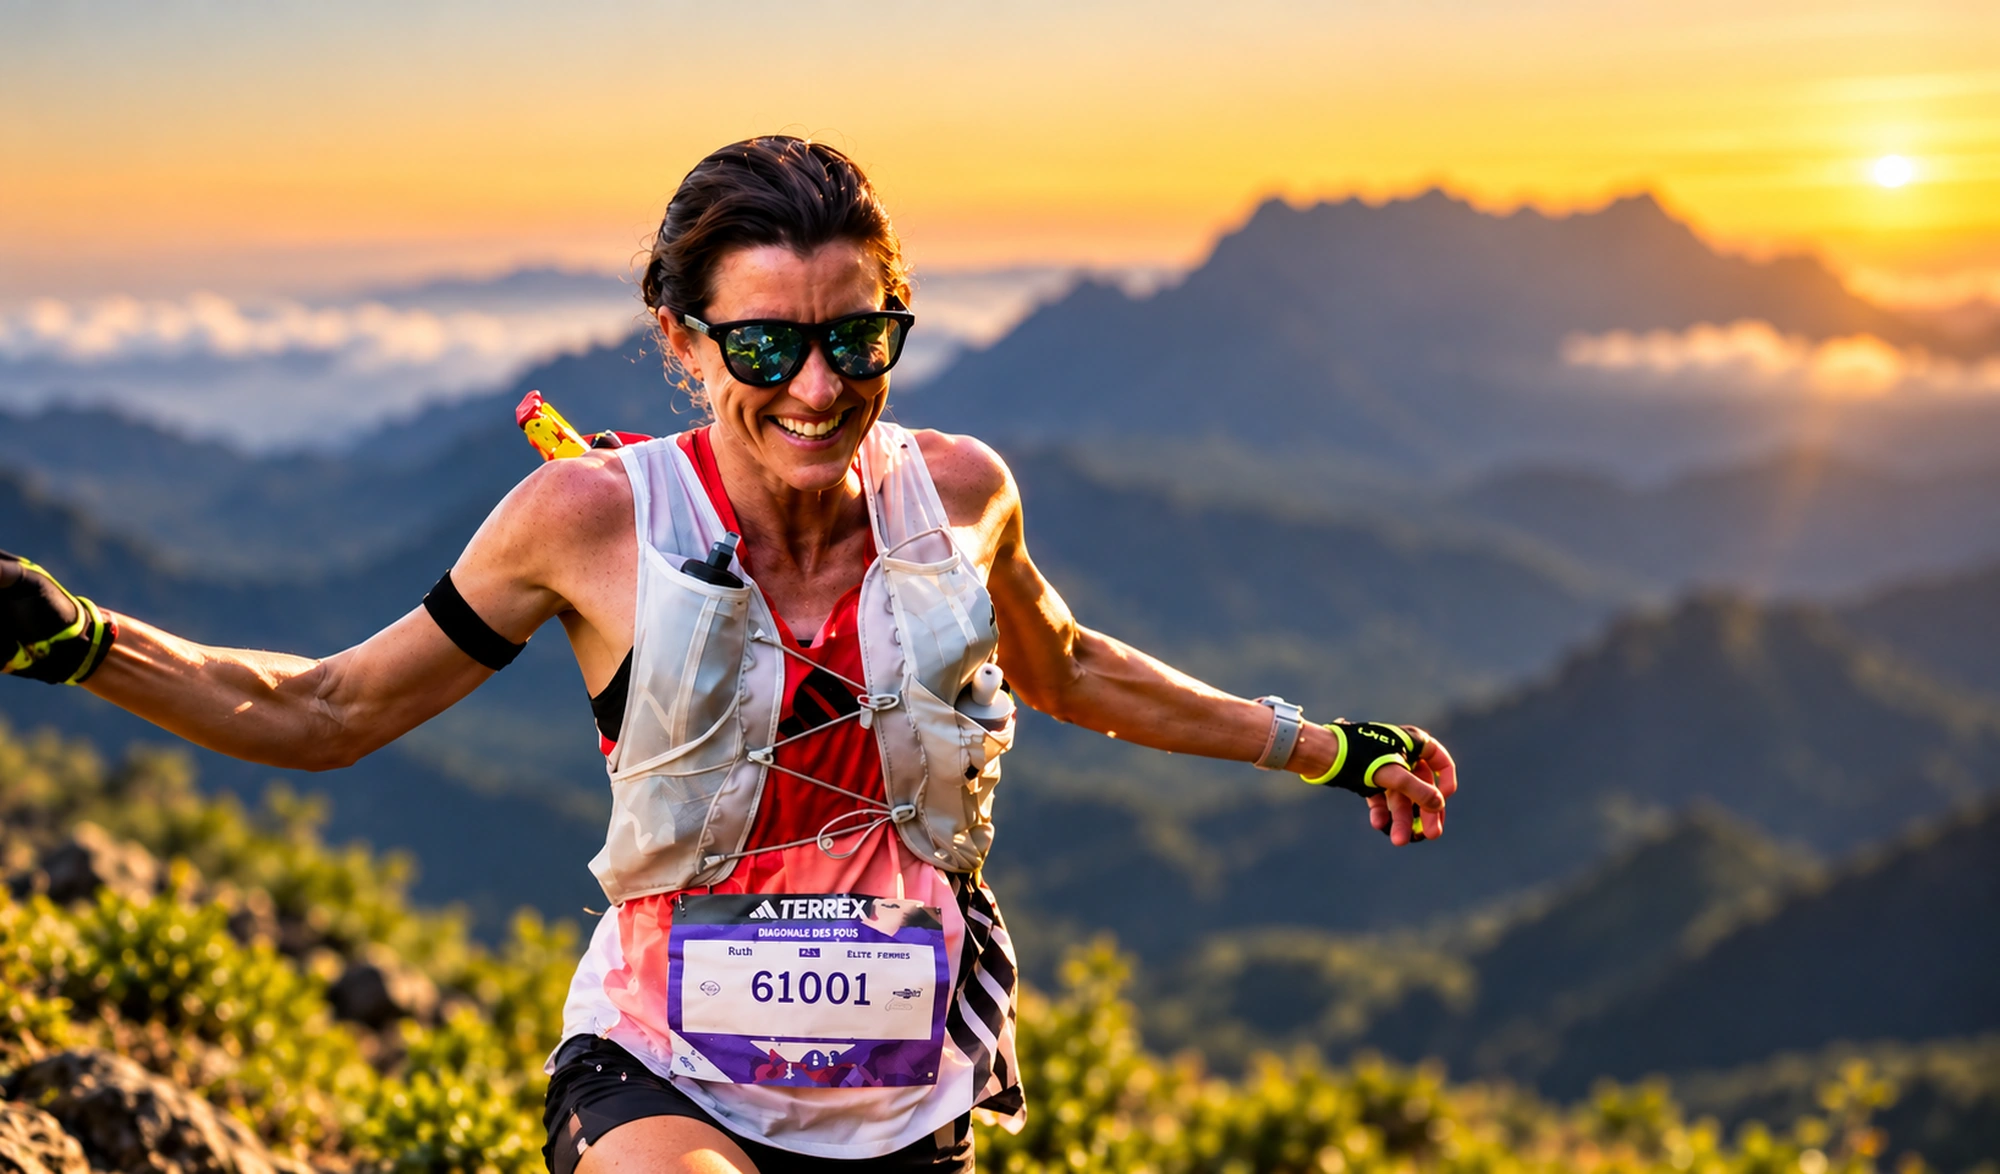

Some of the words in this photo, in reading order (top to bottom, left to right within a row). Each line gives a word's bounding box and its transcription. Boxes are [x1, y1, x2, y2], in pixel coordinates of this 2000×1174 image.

[780, 898, 867, 920] TERREX
[758, 928, 810, 938] DIAGONALE
[812, 928, 831, 938] DES
[833, 929, 859, 938] FOUS
[728, 946, 753, 956] Ruth
[751, 970, 871, 1006] 61001
